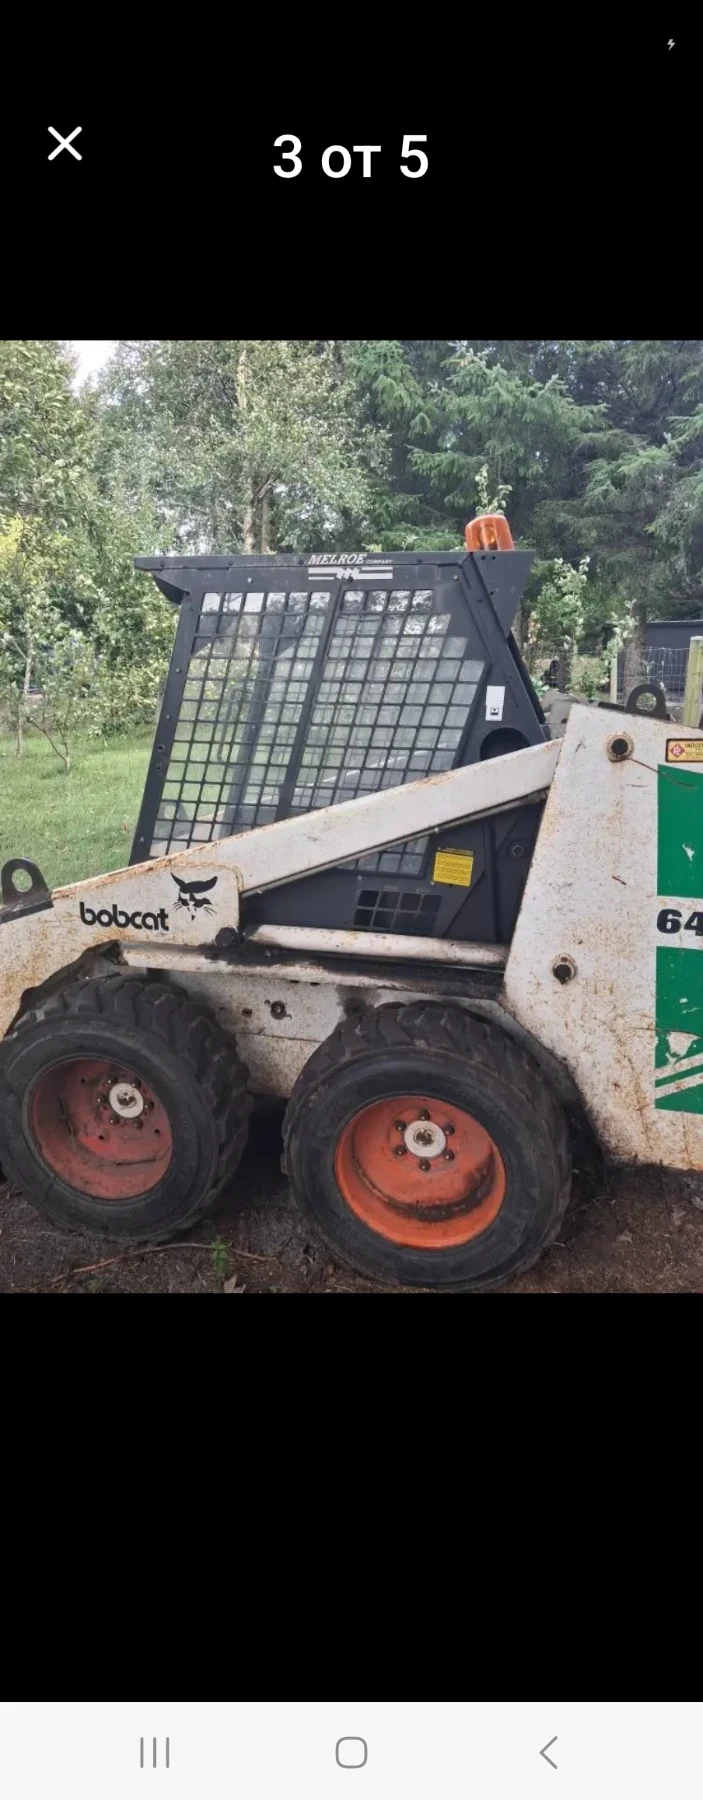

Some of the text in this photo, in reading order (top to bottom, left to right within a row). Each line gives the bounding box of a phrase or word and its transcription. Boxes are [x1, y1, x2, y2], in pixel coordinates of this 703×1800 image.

[308, 553, 367, 565] MELROE
[79, 901, 169, 931] bobcat
[656, 908, 703, 936] 64
